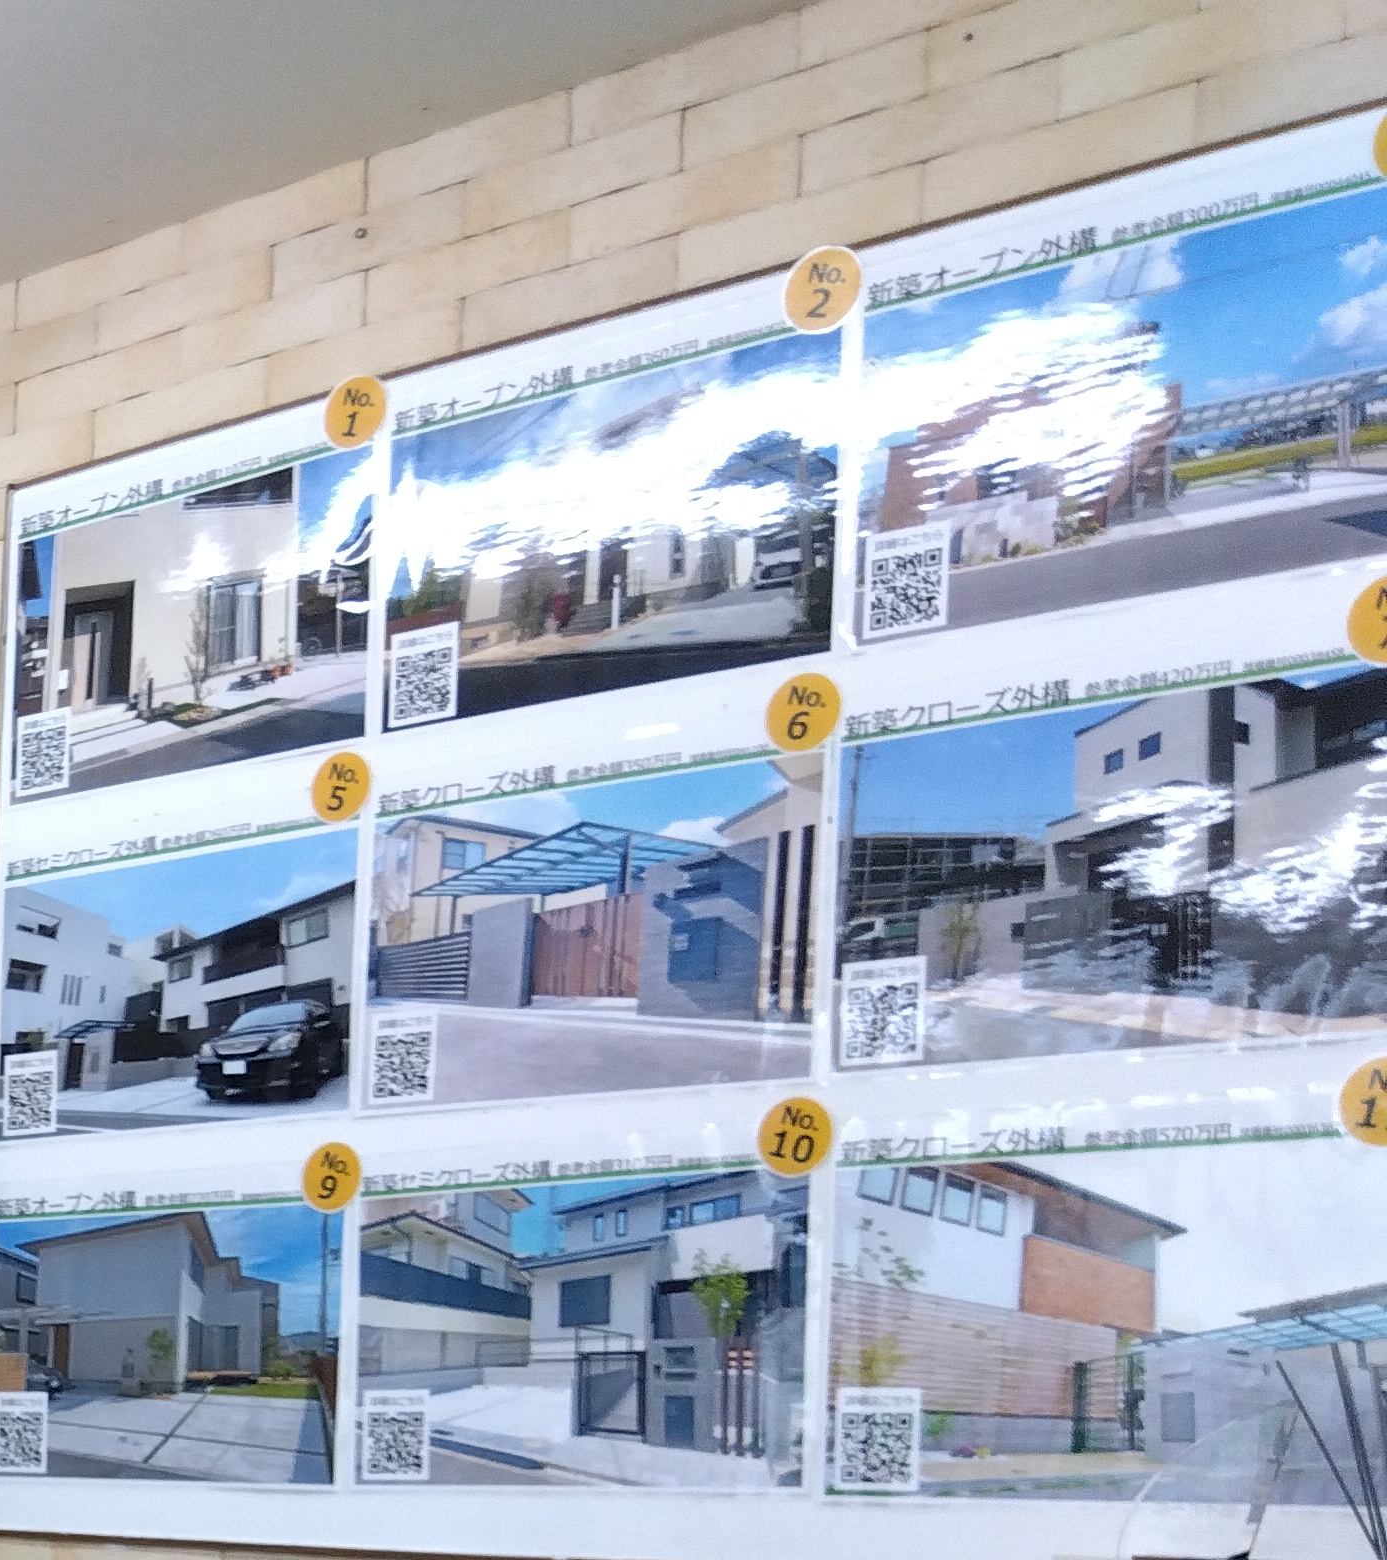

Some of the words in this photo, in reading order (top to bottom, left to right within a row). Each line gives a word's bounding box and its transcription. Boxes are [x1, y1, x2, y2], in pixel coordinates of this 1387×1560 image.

[807, 262, 846, 284] No.
[867, 226, 1097, 306] 新築オープン外構
[805, 289, 831, 319] 2
[342, 388, 375, 408] No.
[396, 367, 573, 431] 新築オープン外構
[341, 411, 359, 438] 1
[787, 685, 825, 708] No.
[845, 679, 1070, 738] 新築クローズ外構
[788, 711, 809, 739] 6
[328, 763, 359, 784] No.
[327, 786, 345, 811] 5
[781, 1106, 818, 1131] No.
[768, 1131, 815, 1164] 10
[318, 1175, 338, 1200] 9
